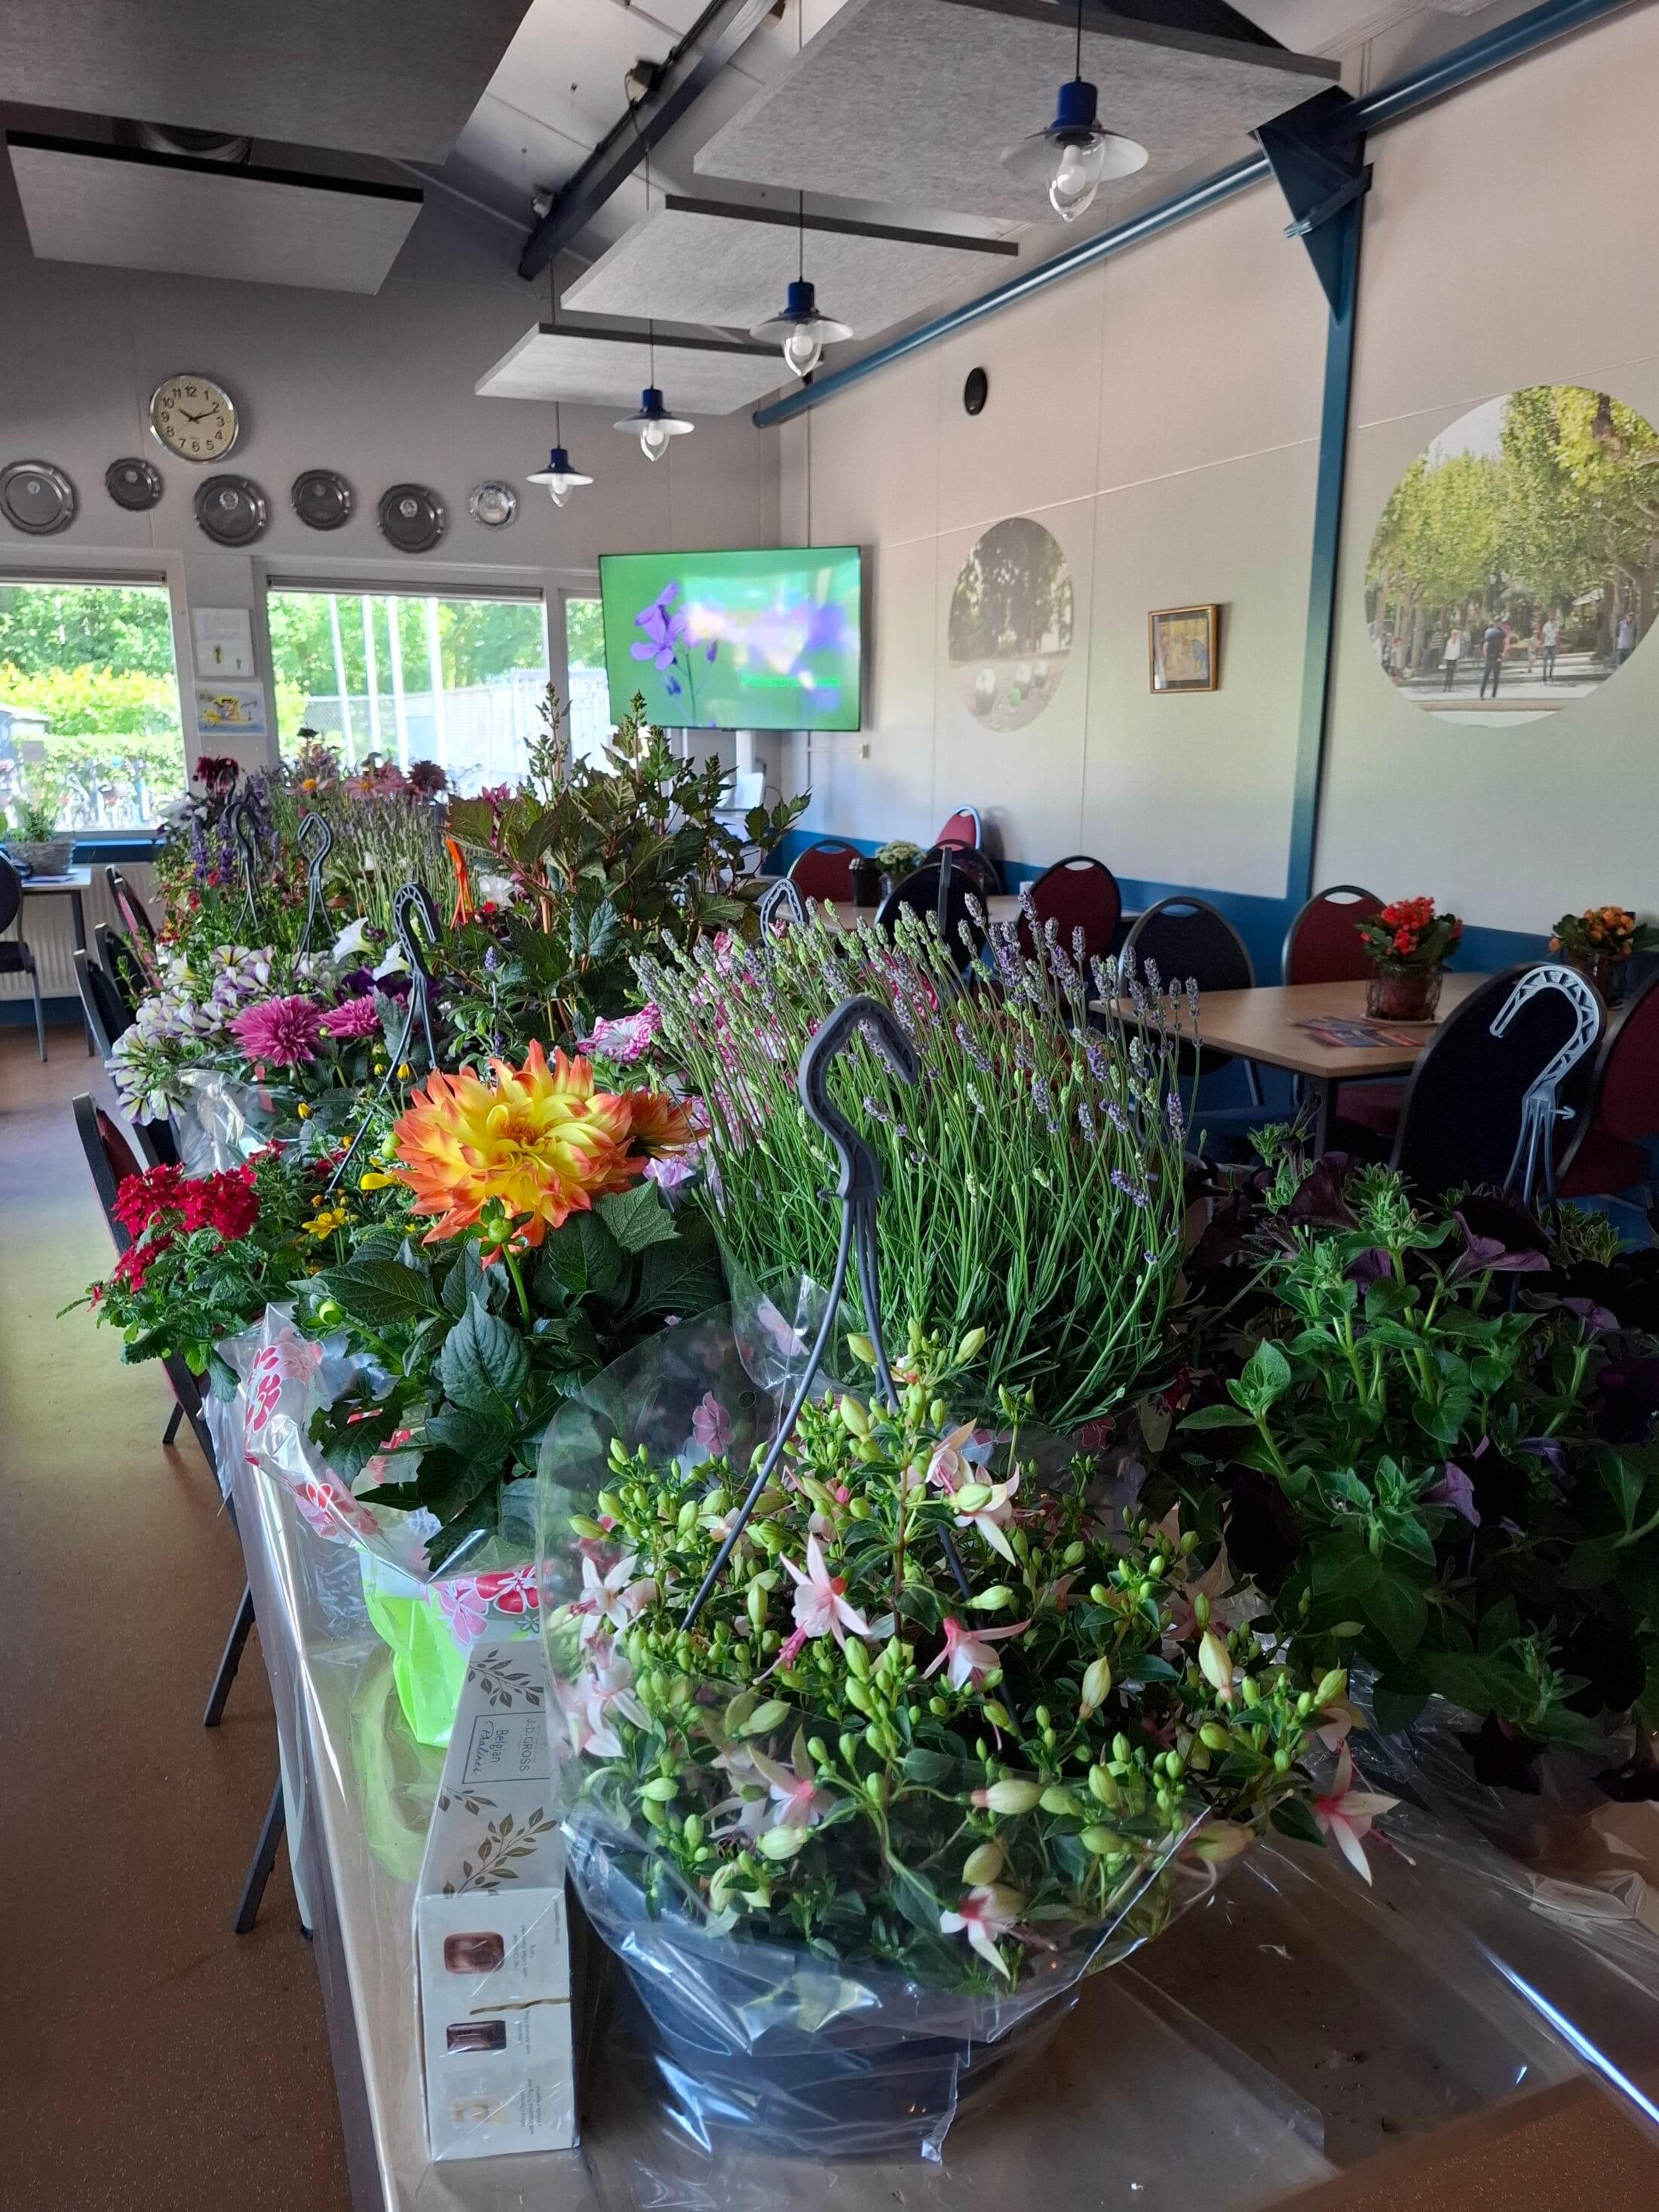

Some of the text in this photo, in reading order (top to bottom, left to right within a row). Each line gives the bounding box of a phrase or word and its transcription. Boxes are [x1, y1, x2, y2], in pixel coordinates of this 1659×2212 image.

[172, 388, 182, 398] 11
[184, 385, 198, 397] 12
[204, 390, 210, 401] 1
[161, 397, 174, 409] 10
[211, 401, 220, 413] 2
[161, 411, 170, 422] 9
[216, 416, 225, 427] 3
[166, 425, 175, 437] 8
[215, 431, 222, 440] 4
[178, 437, 186, 449] 7
[192, 440, 200, 453] 6
[206, 440, 214, 450] 5
[472, 1720, 495, 1776] Pralines
[489, 1729, 510, 1763] Belgian
